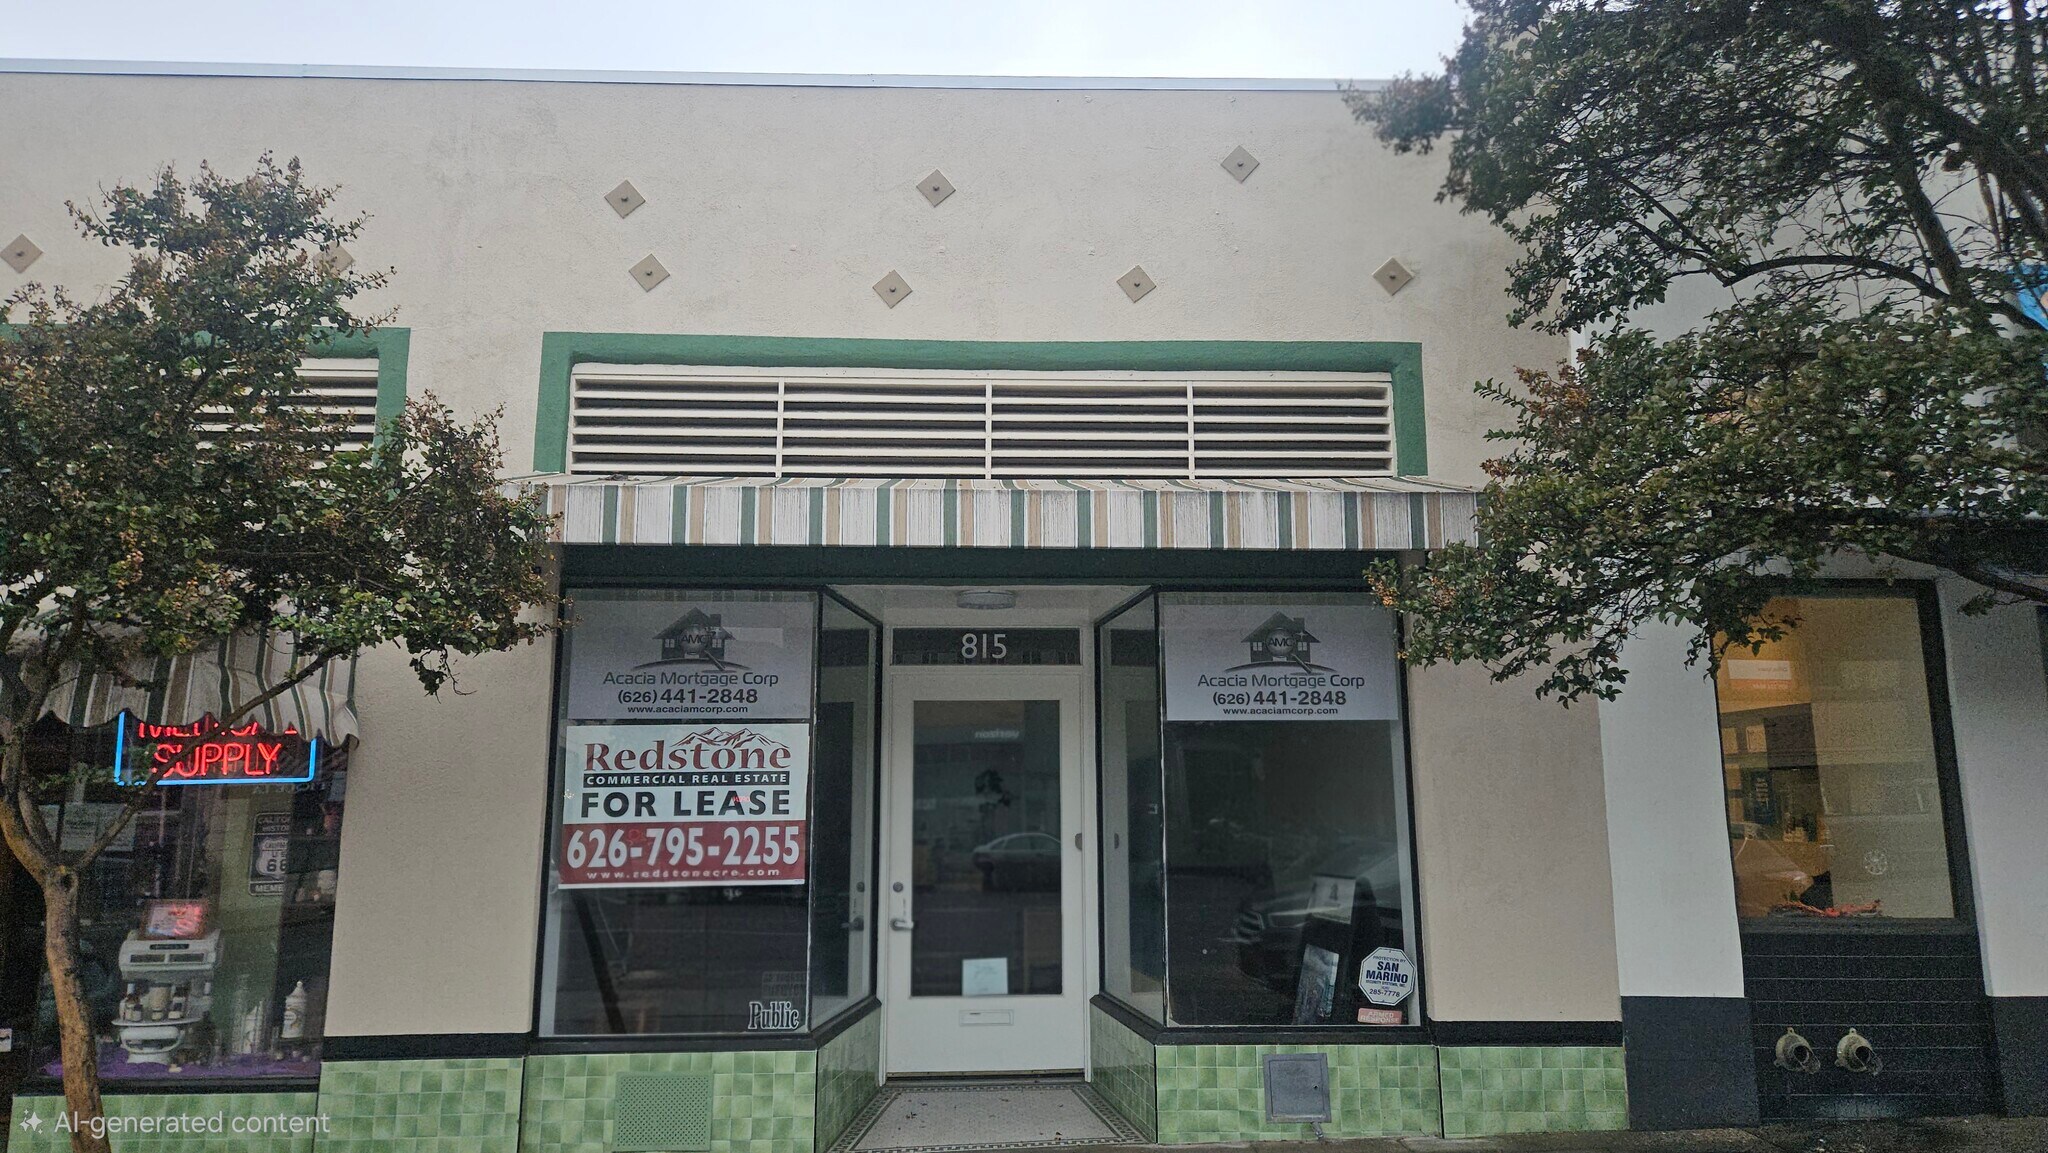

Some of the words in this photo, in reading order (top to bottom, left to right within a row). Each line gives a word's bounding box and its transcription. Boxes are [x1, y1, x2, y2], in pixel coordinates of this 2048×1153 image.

[961, 633, 1007, 659] 815
[603, 672, 657, 685] Acacia
[660, 671, 738, 687] Mortgage
[742, 672, 779, 687] Corp
[1197, 674, 1248, 687] Acacia
[1251, 674, 1326, 689] Mortgage
[1330, 674, 1365, 689] Corp
[627, 705, 748, 715] www.acaciamcorp.com
[1223, 707, 1338, 716] www.acaciamcorp.com
[152, 743, 282, 777] SUPPLY
[584, 740, 791, 771] Redstone
[586, 775, 685, 785] COMMERCIAL
[692, 774, 728, 783] REAL
[735, 774, 787, 783] ESTATE
[581, 791, 657, 818] FOR
[673, 790, 790, 816] LEASE
[566, 826, 800, 868] 626-795-2255
[1377, 961, 1399, 972] SAN
[1366, 970, 1408, 983] MARINO
[747, 1001, 799, 1029] Public
[1360, 1015, 1399, 1023] RESPONSE
